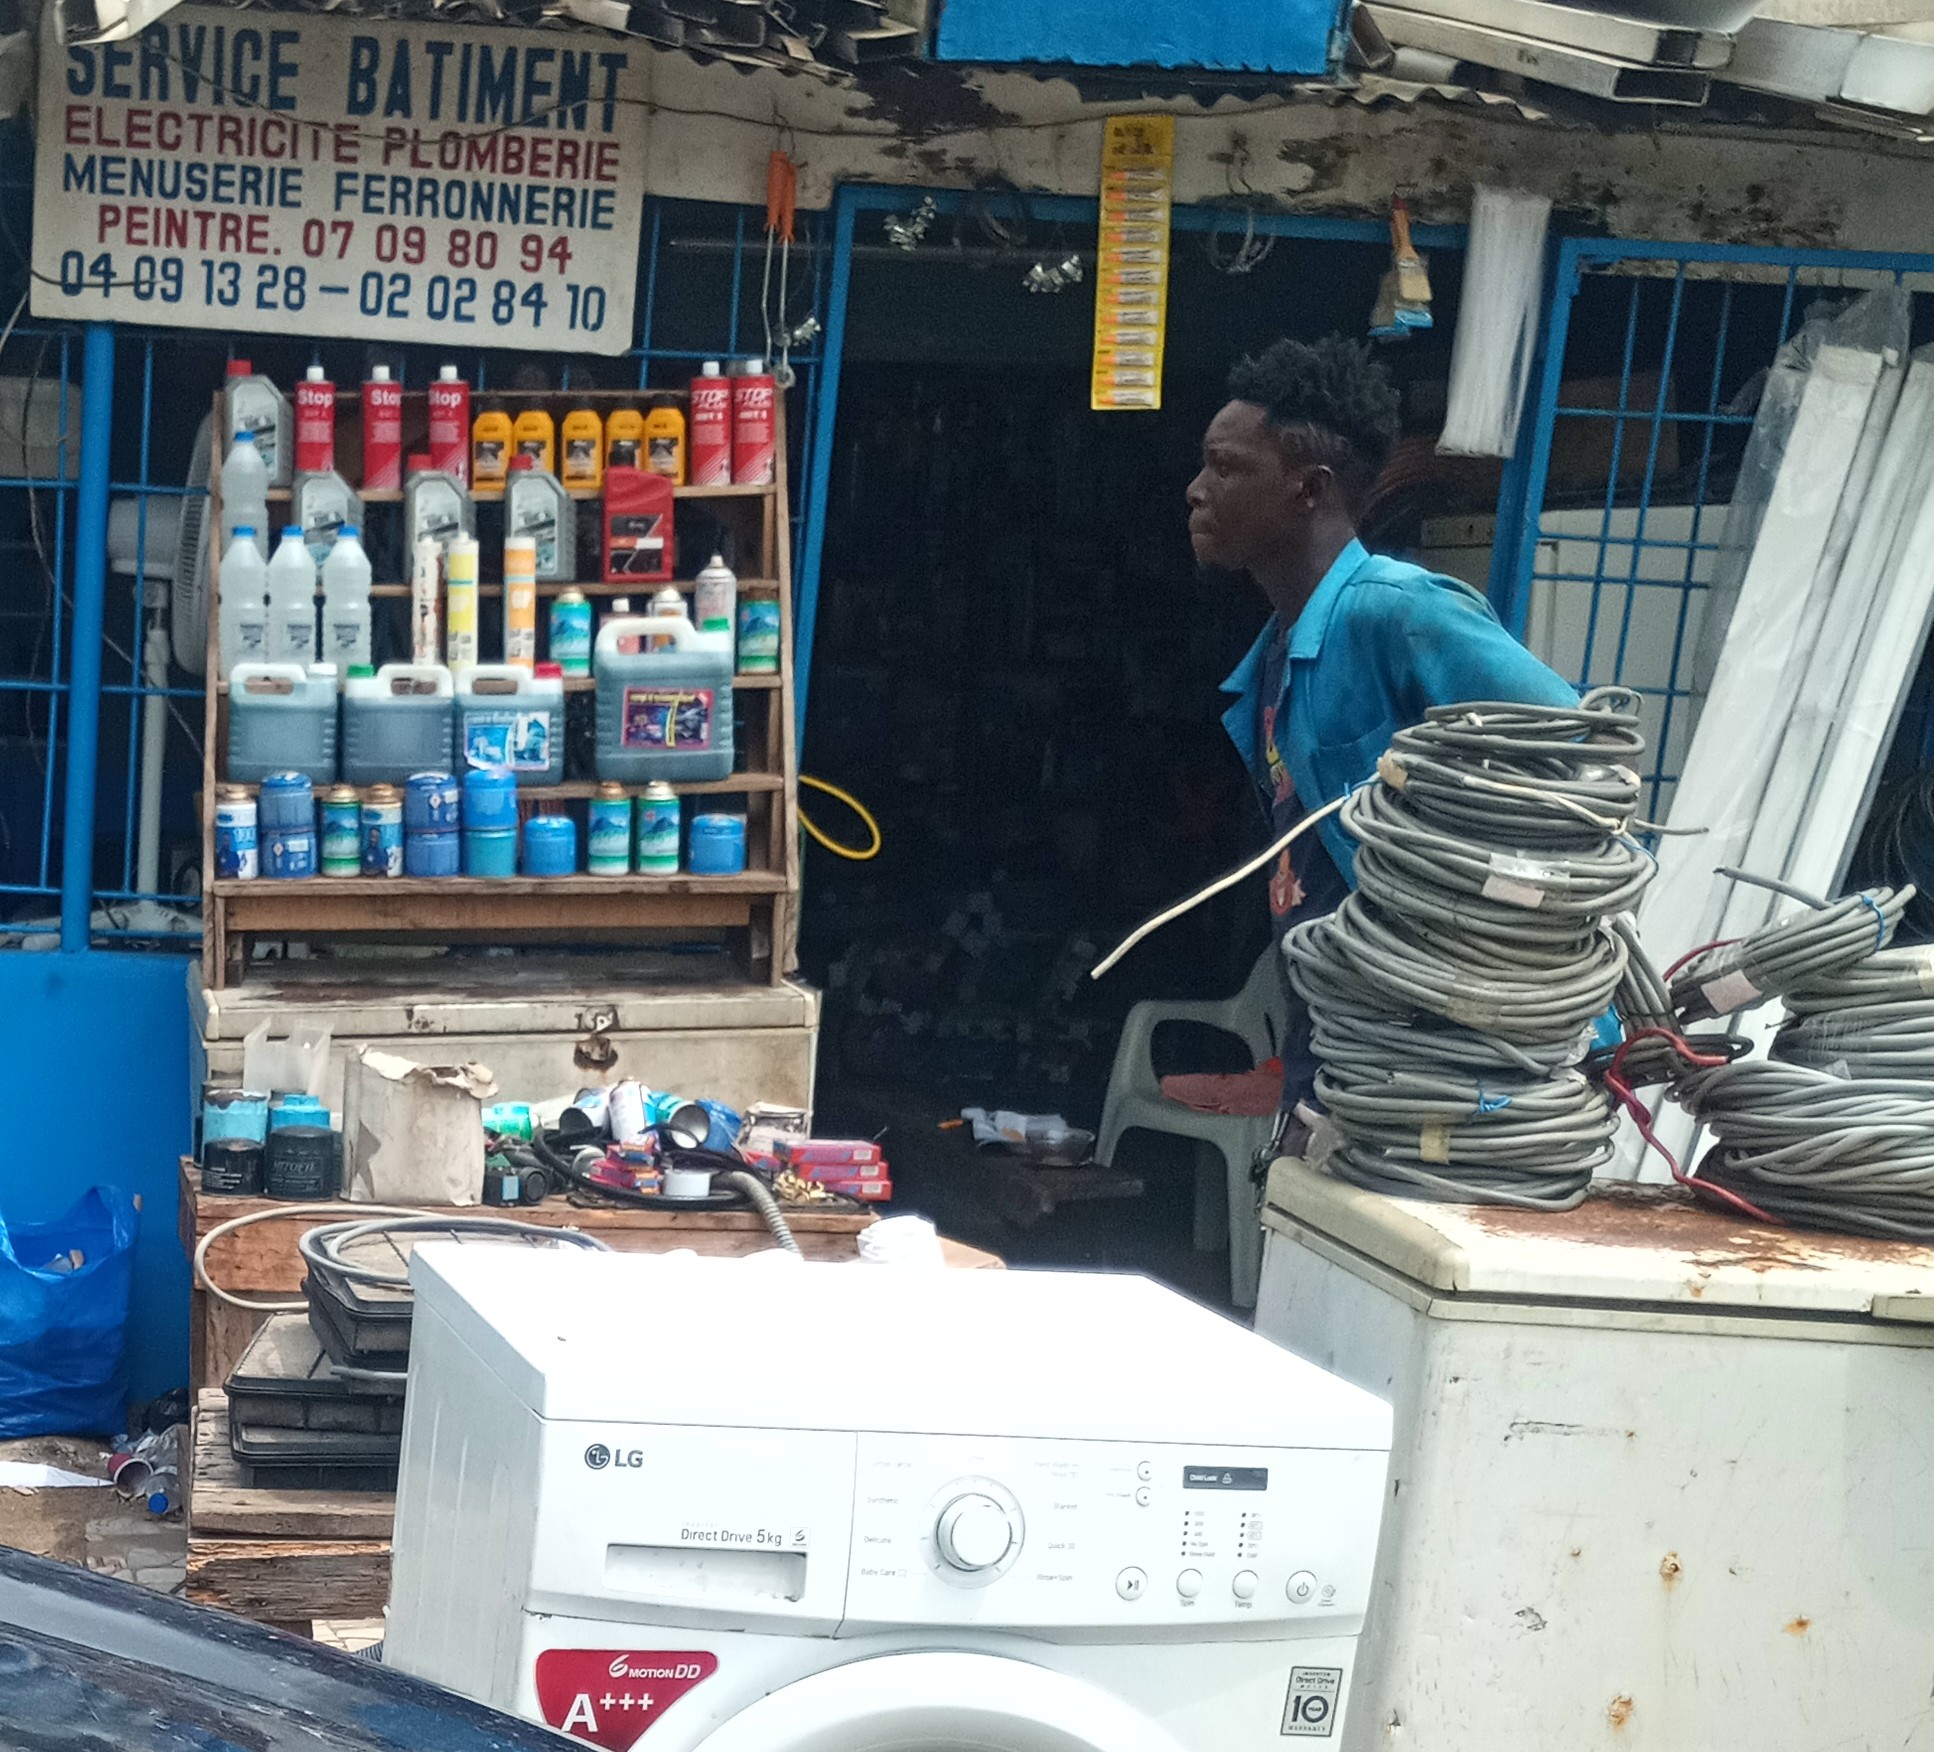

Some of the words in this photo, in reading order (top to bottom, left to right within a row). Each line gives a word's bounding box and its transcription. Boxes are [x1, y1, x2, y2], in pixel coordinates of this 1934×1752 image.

[65, 21, 300, 110] SERVICE
[346, 36, 628, 132] BATIMENT
[64, 104, 360, 165] ELECTRICITE
[382, 126, 621, 182] PLOMBERIE
[63, 153, 303, 208] MENUSERIE
[334, 171, 616, 230] FERRONNERIE
[98, 204, 282, 256] PEINTRE.
[303, 218, 354, 259] 07
[375, 223, 426, 264] 09
[448, 228, 499, 270] 80
[520, 234, 573, 275] 94
[60, 250, 117, 298] 04
[133, 255, 184, 303] 09
[201, 259, 242, 306] 13
[256, 264, 307, 312] 28
[359, 271, 411, 319] 02
[427, 275, 477, 323] 02
[492, 279, 548, 328] 84
[566, 283, 607, 332] 10
[298, 388, 334, 409] Stop
[371, 389, 401, 407] Sto
[614, 1448, 644, 1468] LG
[681, 1528, 718, 1542] Direct
[721, 1530, 753, 1543] Drive
[628, 1668, 674, 1679] MOTION
[674, 1664, 701, 1679] DD
[1291, 1695, 1329, 1723] 10
